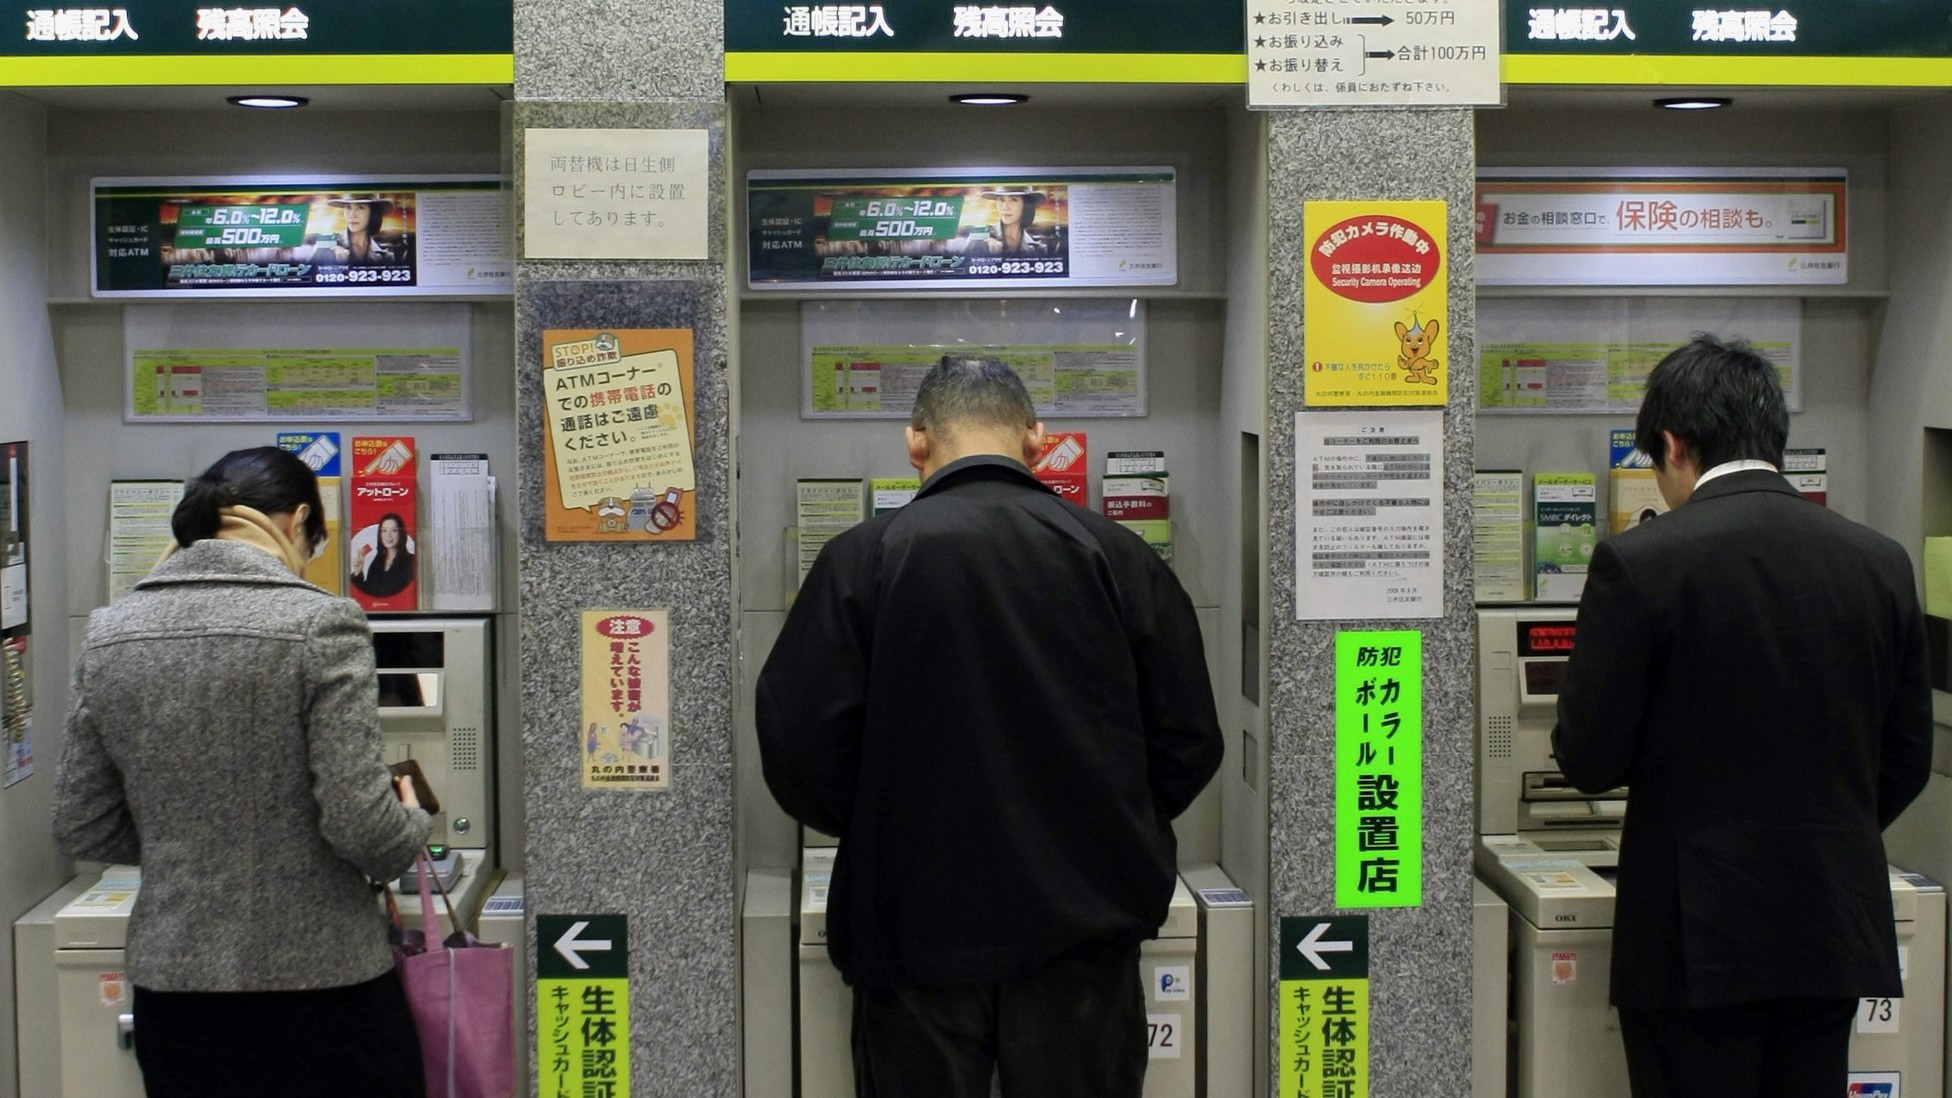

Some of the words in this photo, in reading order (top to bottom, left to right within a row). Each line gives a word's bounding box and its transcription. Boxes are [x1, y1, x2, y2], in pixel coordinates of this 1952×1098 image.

[26, 9, 138, 41] 通帳記入
[197, 8, 309, 40] 残高照会
[783, 6, 894, 38] 通帳記入
[953, 6, 1064, 38] 残高照会
[1405, 11, 1455, 25] 50万円
[1528, 9, 1635, 41] 通帳記入
[1691, 9, 1798, 42] 残高照会
[1397, 46, 1486, 61] 合計100万円
[1272, 82, 1451, 93] くわしくは、係員におたずね下さい。
[550, 156, 676, 174] 両替機は日生側
[552, 184, 686, 201] ロビー内に設置
[553, 210, 665, 228] してあります。
[1615, 200, 1774, 231] 保険の相談も。
[762, 241, 802, 249] 対応ATM
[1318, 221, 1430, 258] 防犯カメラ作動中
[108, 248, 149, 257] 対応ATM
[316, 270, 411, 283] 0120-923-923
[968, 261, 1063, 275] 0120-923-923
[1332, 277, 1360, 288] Security
[1361, 277, 1387, 287] Camera
[1388, 277, 1421, 288] Operating
[555, 343, 594, 358] STOP!
[556, 351, 617, 368] 振り込め詐欺
[556, 366, 656, 391] ATMコーナー
[558, 382, 672, 411] での携帯電話の
[561, 404, 659, 432] 通話はご遠慮
[565, 431, 636, 451] ください。
[357, 487, 409, 497] アットローン
[1053, 485, 1080, 494] ローン
[609, 619, 641, 634] 注意
[1356, 646, 1402, 667] 防犯
[1355, 677, 1377, 767] ボール
[1379, 678, 1401, 766] カラー
[1356, 774, 1400, 894] 設置店
[1555, 914, 1576, 922] OKI
[1866, 999, 1892, 1022] 73
[1148, 1023, 1173, 1047] 72
